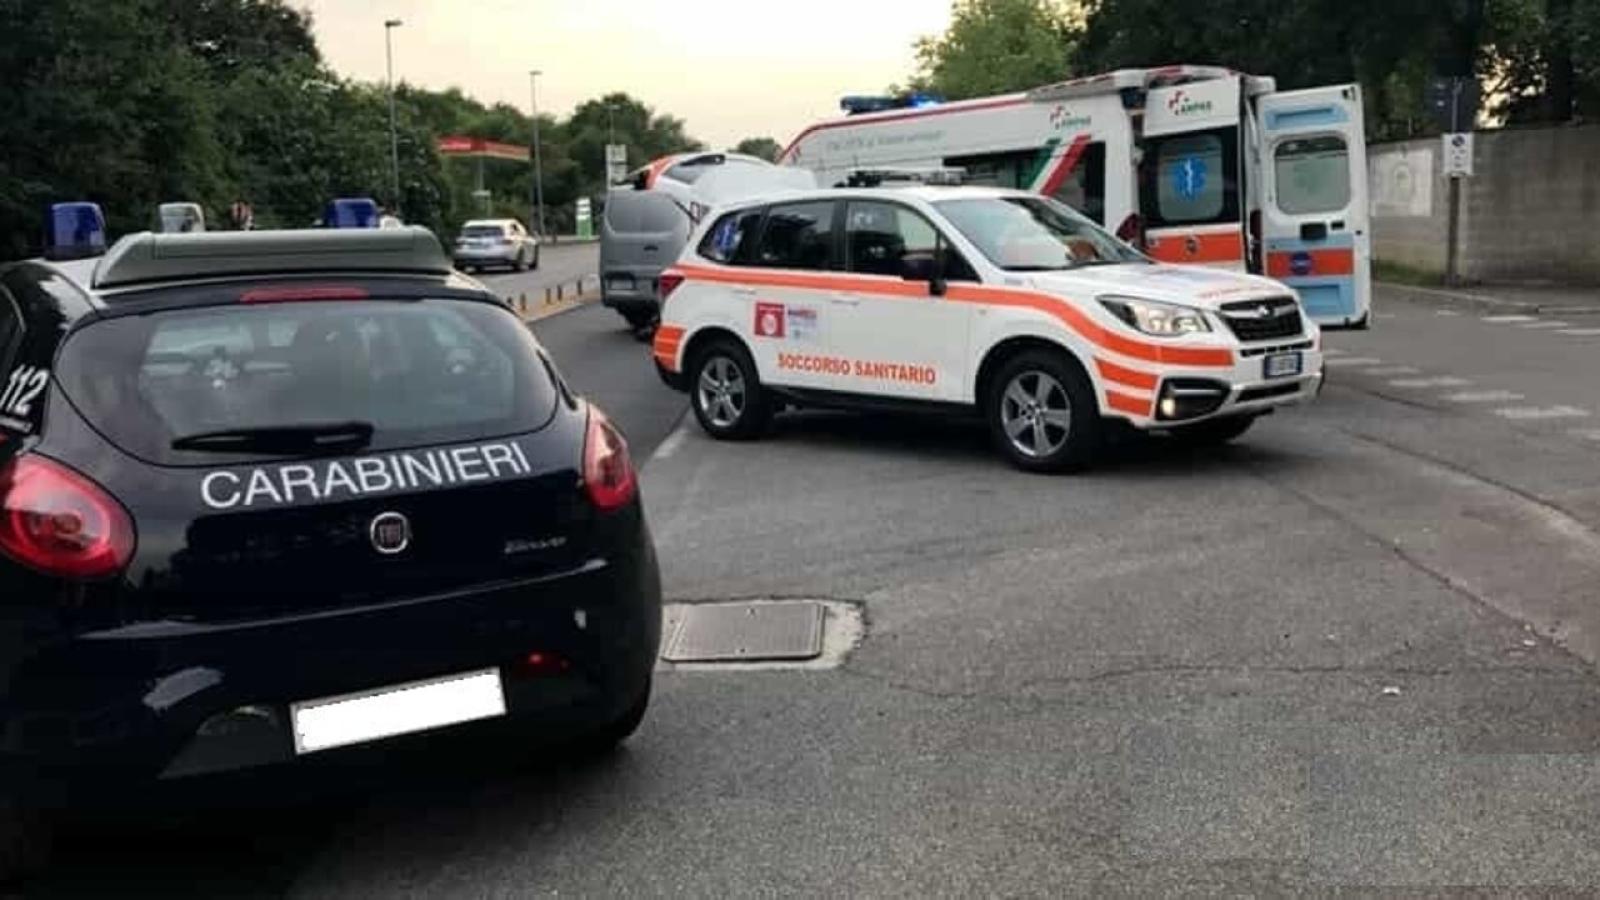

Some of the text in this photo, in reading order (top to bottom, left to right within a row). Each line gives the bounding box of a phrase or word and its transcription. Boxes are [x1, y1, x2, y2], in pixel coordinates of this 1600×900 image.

[0, 363, 49, 416] 112
[777, 352, 936, 385] SOCCORSO SANITARIO
[201, 441, 531, 509] CARABINIERI
